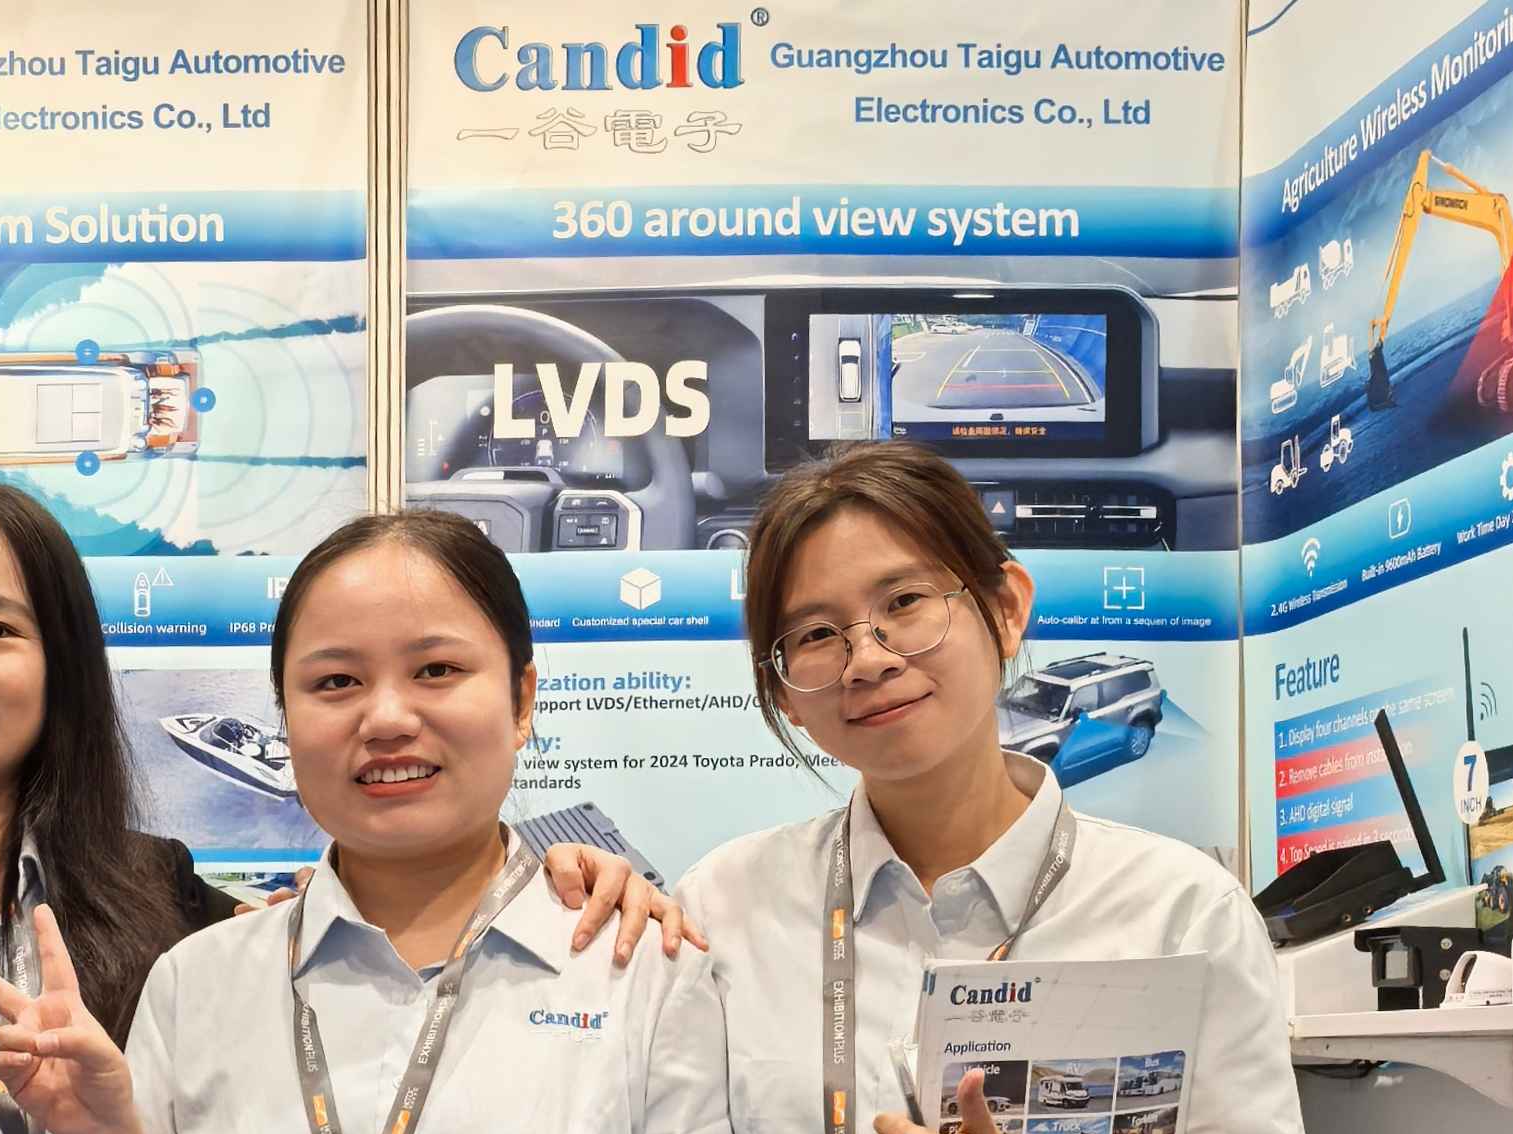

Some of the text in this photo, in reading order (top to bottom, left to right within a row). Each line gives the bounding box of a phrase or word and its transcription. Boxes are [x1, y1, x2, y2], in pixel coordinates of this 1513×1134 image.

[75, 49, 159, 82] Taigu
[168, 49, 345, 75] Automotive
[454, 23, 745, 92] Candid
[771, 42, 1224, 75] Guangzhou Taigu Automotive
[153, 103, 211, 133] Co.,
[223, 103, 270, 129] Ltd
[855, 97, 1151, 128] Electronics Co., Ltd
[1282, 133, 1358, 214] Agriculture
[1360, 80, 1427, 152] Wireless
[46, 203, 224, 244] Solution
[552, 197, 1079, 246] 360 around view system
[493, 360, 711, 439] LVDS
[101, 622, 207, 637] Collision warning
[229, 622, 256, 634] IP68
[572, 616, 709, 628] Customized special car shell
[612, 671, 691, 693] ability:
[1274, 653, 1340, 700] Feature
[523, 754, 800, 772] view system for 2024 Toyota Prado,
[1463, 754, 1477, 792] 7
[950, 981, 1033, 1005] Candid
[529, 1008, 602, 1030] Candid
[944, 1040, 1011, 1056] Application
